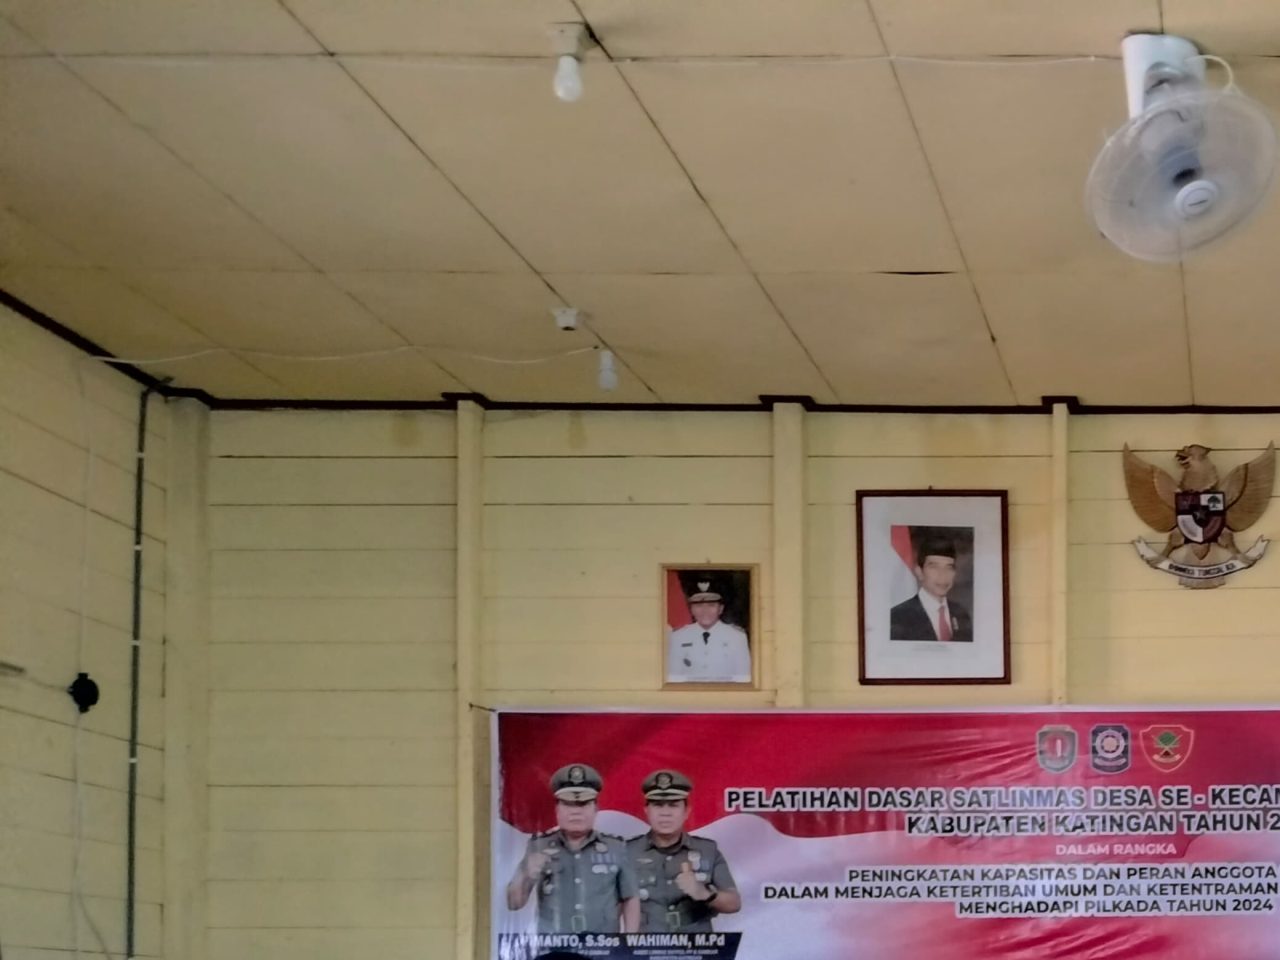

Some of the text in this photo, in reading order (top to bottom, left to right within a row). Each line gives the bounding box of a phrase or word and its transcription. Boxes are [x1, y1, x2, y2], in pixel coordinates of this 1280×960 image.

[727, 790, 858, 808] PELATIHAN
[866, 790, 944, 808] DASAR
[952, 788, 1084, 808] SATLINMAS
[1091, 788, 1156, 807] DESA
[1162, 788, 1189, 806] SE
[908, 815, 1045, 834] KABUPATEN
[1056, 813, 1174, 833] KATINGAN
[1183, 813, 1260, 832] TAHUN
[1055, 843, 1177, 856] DALAM RANGKA
[848, 869, 974, 882] PENINGKATAN
[981, 868, 1077, 881] KAPASITAS
[1083, 867, 1120, 880] DAN
[1127, 867, 1185, 880] PERAN
[1191, 866, 1276, 879] ANGGOTA
[764, 886, 828, 899] DALAM
[834, 886, 920, 899] MENJAGA
[926, 885, 1035, 898] KETERTIBAN
[1042, 884, 1097, 897] UMUM
[1103, 883, 1141, 896] DAN
[1147, 882, 1278, 896] KETENTRAMAN
[959, 898, 1273, 914] MENGHADAPI PILKADA TAHUN 2024
[585, 934, 620, 947] S.Sos
[626, 934, 725, 949] WAHIMAN, M.Pd
